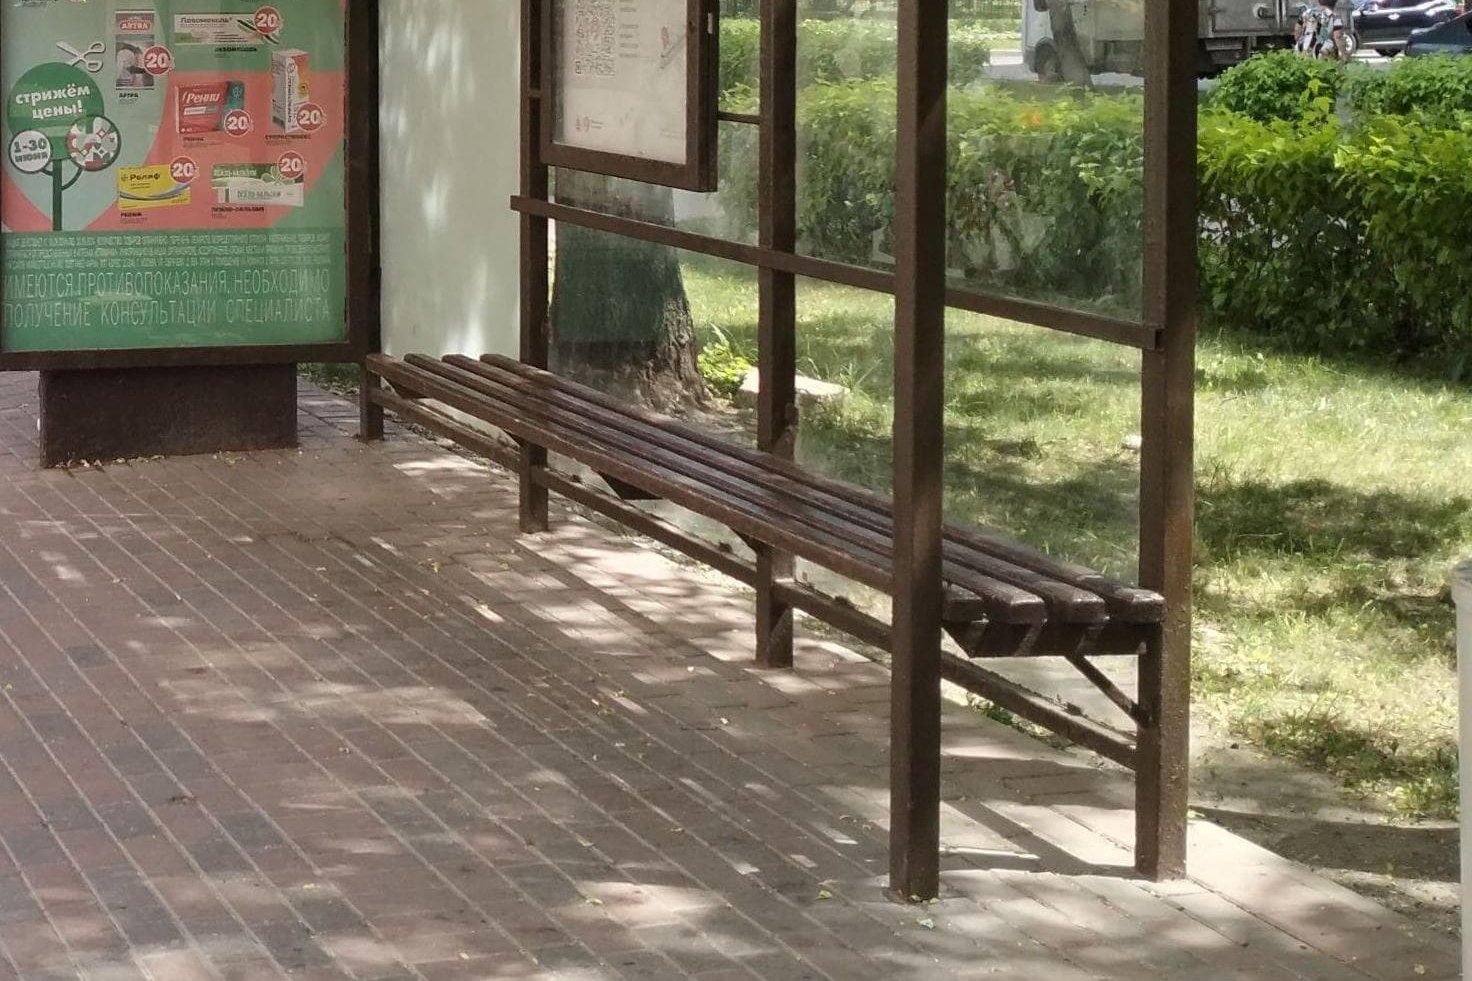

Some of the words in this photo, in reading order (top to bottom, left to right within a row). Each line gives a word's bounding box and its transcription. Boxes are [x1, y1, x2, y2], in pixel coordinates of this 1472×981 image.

[15, 83, 91, 106] стрижём
[31, 100, 84, 120] цены!
[13, 137, 48, 153] 1-30
[3, 272, 74, 298] ИМЕЮТСЯ
[232, 269, 330, 297] НЕОБХОДИМО
[3, 301, 91, 328] ПОЛУЧЕНИЕ
[100, 299, 217, 327] КОНСУЛЬТАЦИИ
[226, 297, 330, 324] СПЕЦИАЛИСТА
